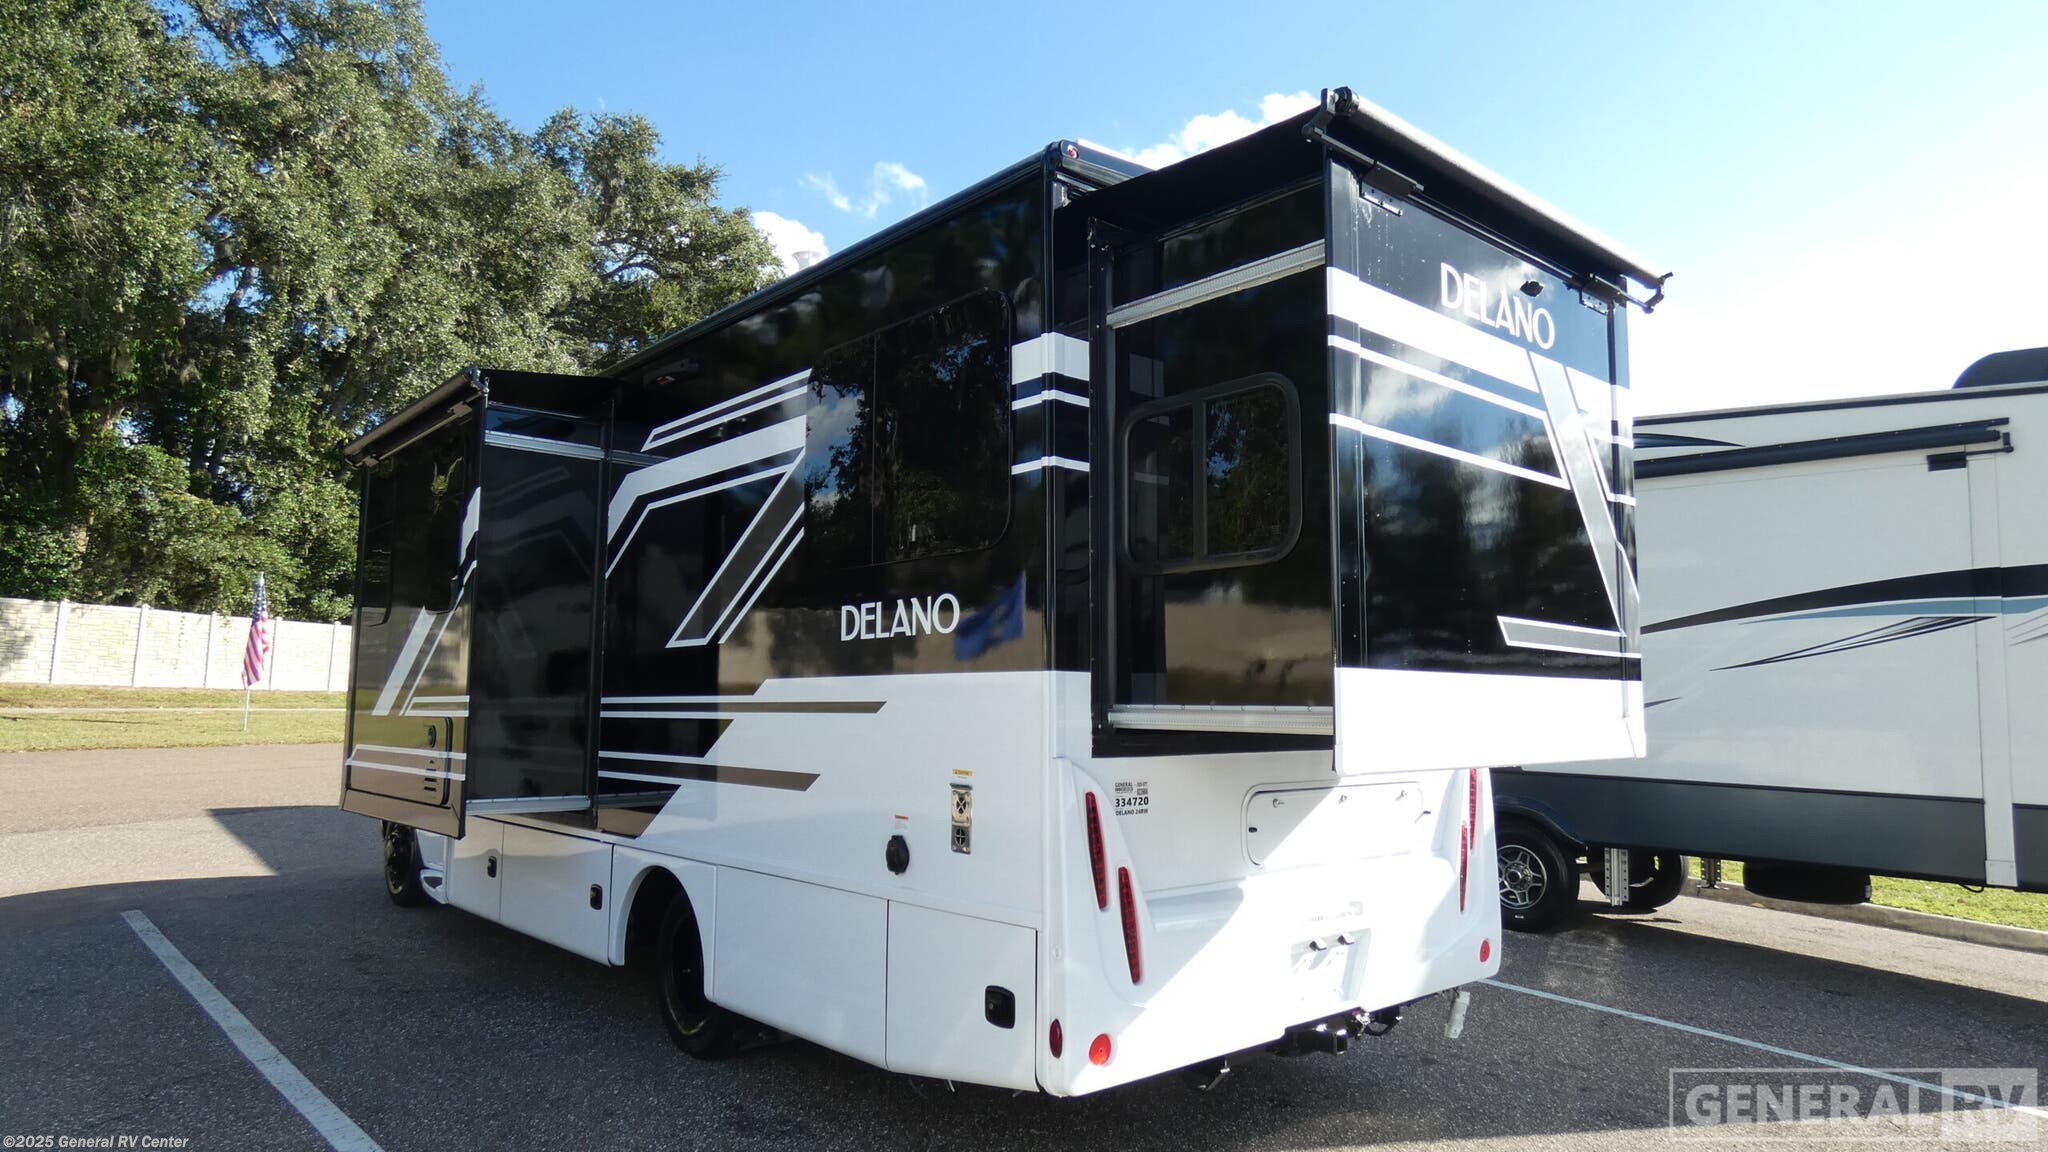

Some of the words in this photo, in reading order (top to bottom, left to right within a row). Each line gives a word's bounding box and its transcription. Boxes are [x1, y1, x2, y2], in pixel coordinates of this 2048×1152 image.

[1441, 262, 1555, 350] DELANO
[840, 593, 960, 641] DELANO
[1115, 796, 1149, 808] 334720
